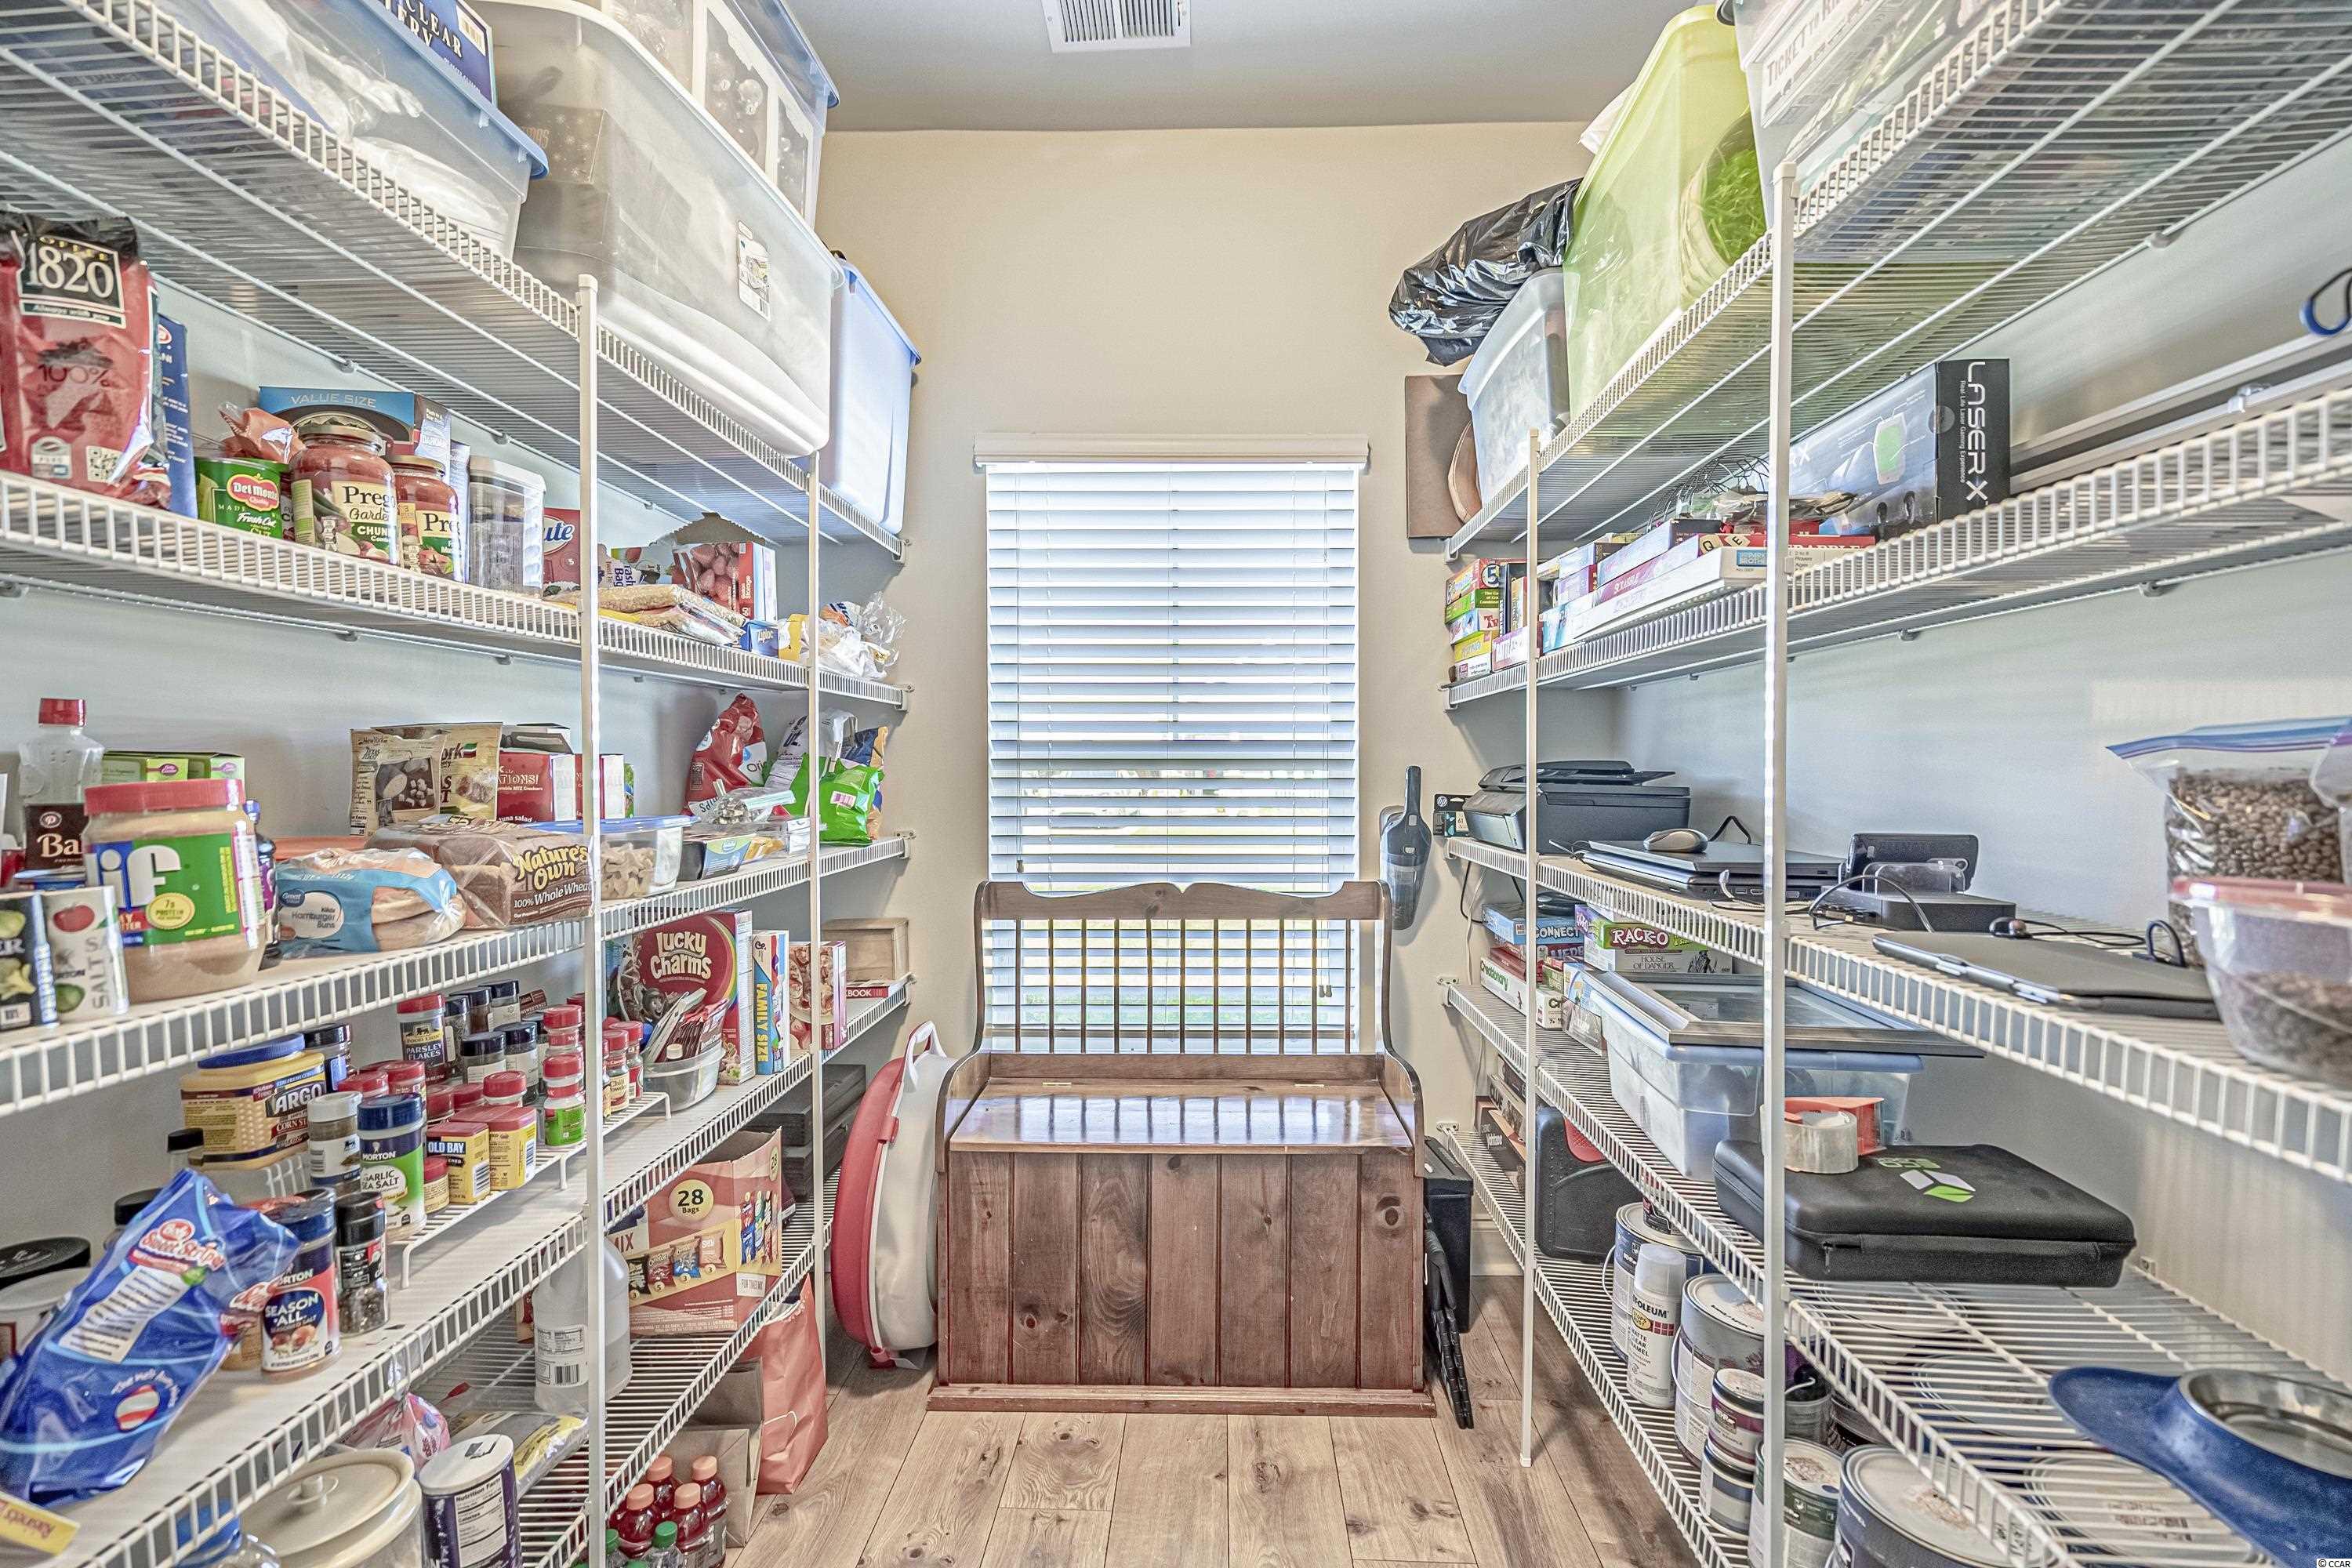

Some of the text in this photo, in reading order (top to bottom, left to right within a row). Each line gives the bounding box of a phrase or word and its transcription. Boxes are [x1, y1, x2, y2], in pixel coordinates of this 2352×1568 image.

[24, 242, 114, 298] 1820
[290, 394, 377, 408] VALUE SIZE
[1965, 361, 1989, 502] LASER X
[232, 481, 252, 493] Del
[356, 525, 389, 536] CHUN
[544, 521, 575, 542] ute
[1701, 536, 1743, 551] Q E
[623, 564, 637, 586] rash
[1487, 566, 1500, 585] 5
[510, 844, 589, 881] Nature's
[533, 861, 576, 891] Own
[514, 881, 593, 909] 100% Whole Wheat
[291, 911, 336, 923] Hamburger
[316, 920, 336, 929] Buns
[1535, 925, 1581, 938] CONNECT
[655, 931, 707, 959] Lucky
[650, 953, 713, 980] Charms
[1646, 961, 1675, 970] DANGER
[756, 983, 769, 1062] FAMILY SIZE
[405, 1042, 442, 1055] PARSLEY
[407, 1049, 441, 1061] FLAKES
[274, 1083, 323, 1114] ARGO
[276, 1120, 299, 1132] CORN
[362, 1151, 397, 1161] MORTON
[427, 1142, 464, 1154] OLD BAY
[376, 1176, 400, 1189] SALT
[677, 1189, 704, 1207] 28
[265, 1292, 319, 1318] SEASON
[456, 1476, 503, 1503] Nutrition Facts
